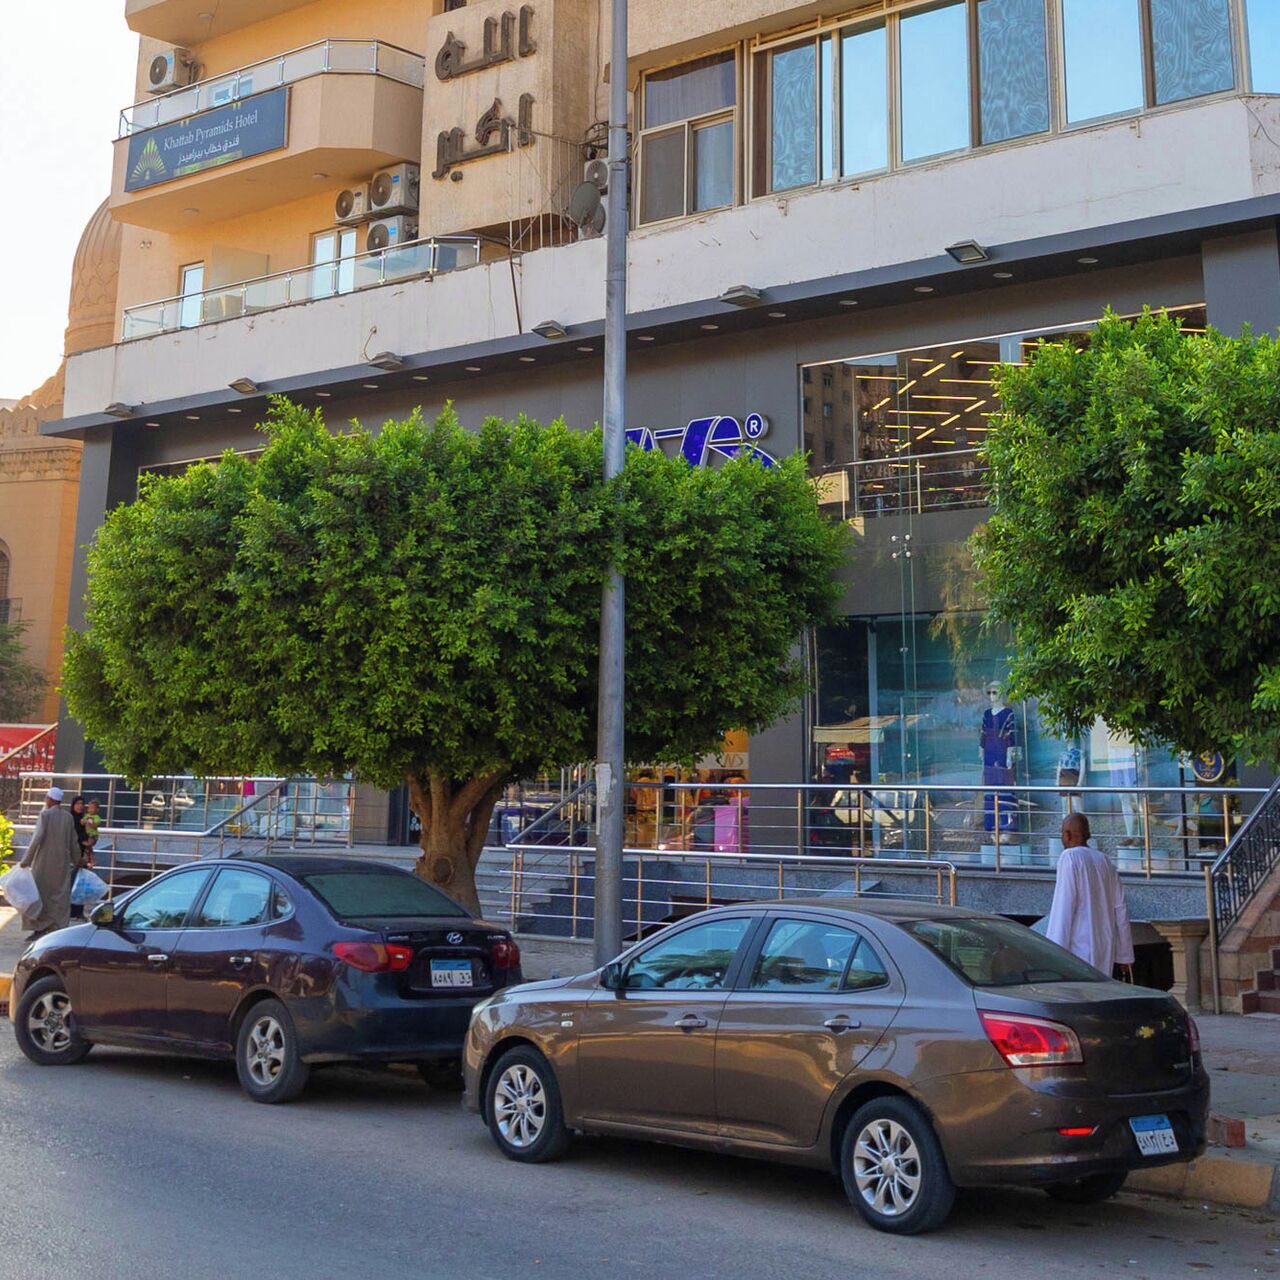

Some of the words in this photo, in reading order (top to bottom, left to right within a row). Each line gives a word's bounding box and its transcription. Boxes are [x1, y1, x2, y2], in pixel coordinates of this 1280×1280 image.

[435, 4, 537, 82] الله
[163, 129, 194, 151] Khattab
[195, 119, 234, 145] Pyramids
[235, 109, 258, 130] Hotel
[223, 133, 240, 152] فندق
[204, 142, 222, 157] خطاب
